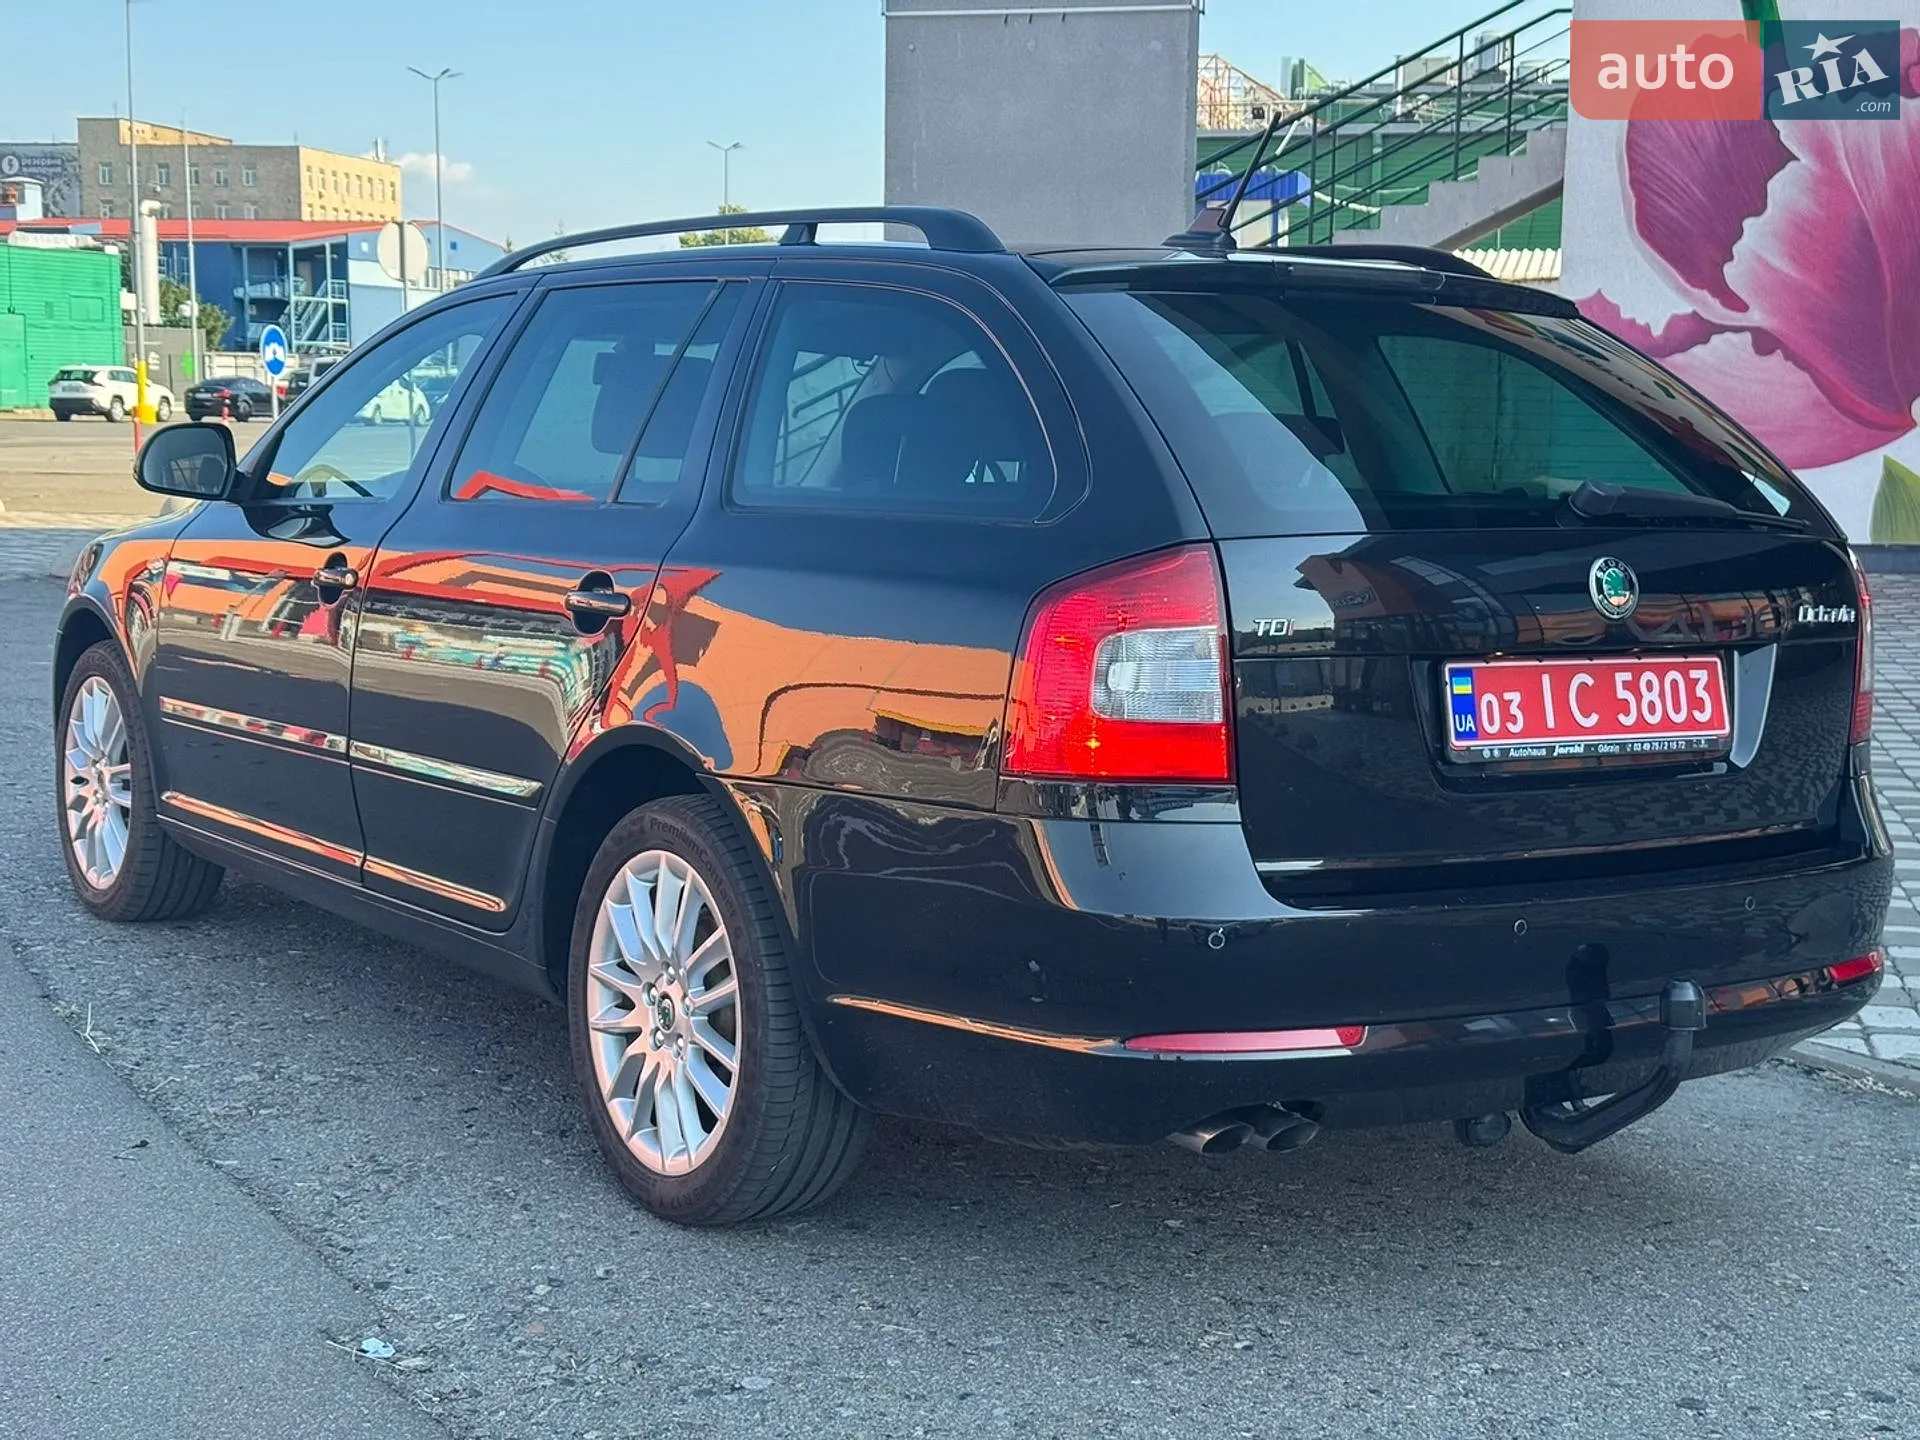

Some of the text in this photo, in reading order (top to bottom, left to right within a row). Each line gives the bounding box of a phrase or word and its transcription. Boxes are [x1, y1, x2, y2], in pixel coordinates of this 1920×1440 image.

[1254, 618, 1295, 637] TDI
[1480, 691, 1524, 735] 03
[1614, 669, 1713, 727] 5803
[1455, 714, 1476, 732] UA
[1508, 747, 1547, 759] Autohaus
